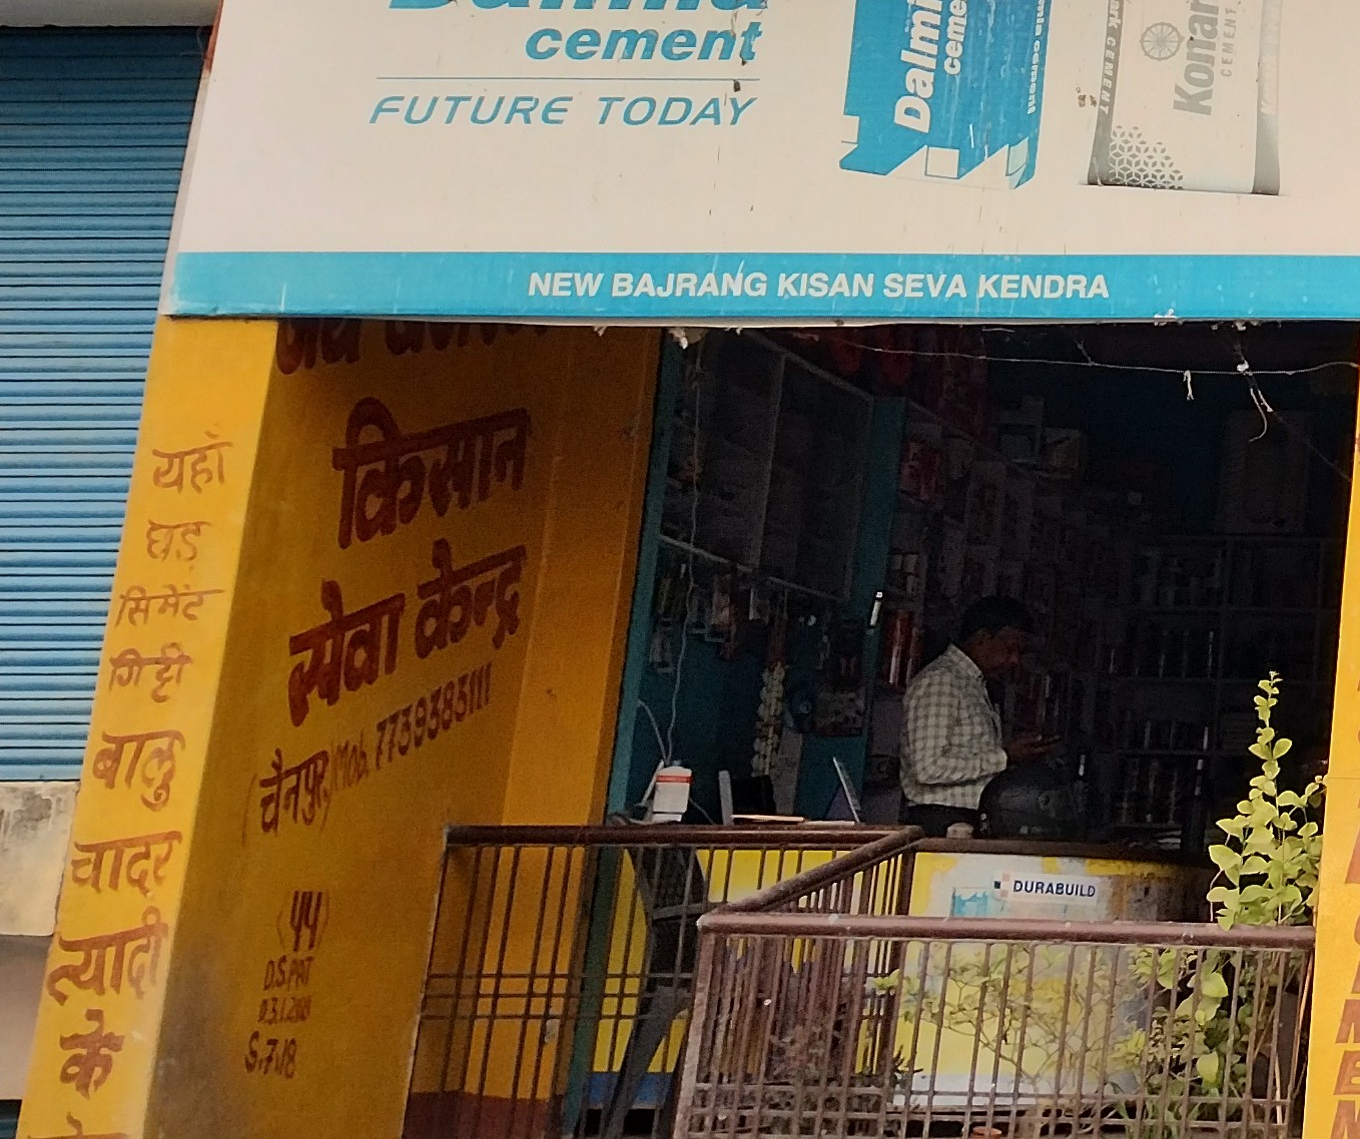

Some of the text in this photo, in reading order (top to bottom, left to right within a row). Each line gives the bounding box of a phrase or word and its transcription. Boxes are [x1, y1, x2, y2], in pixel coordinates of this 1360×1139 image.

[525, 21, 764, 62] cement
[1099, 36, 1118, 115] CEMENT
[1220, 5, 1238, 78] CEMENT
[368, 95, 758, 127] FUTURE TODAY
[527, 272, 1111, 299] NEW BAJRANG KISAN SEVA KENDRA
[331, 395, 534, 551] किसान
[287, 576, 406, 728] सेवा
[375, 662, 493, 770] 7739383111
[70, 829, 184, 898] चादर
[1012, 878, 1097, 900] DURABUILD
[58, 1009, 126, 1100] के
